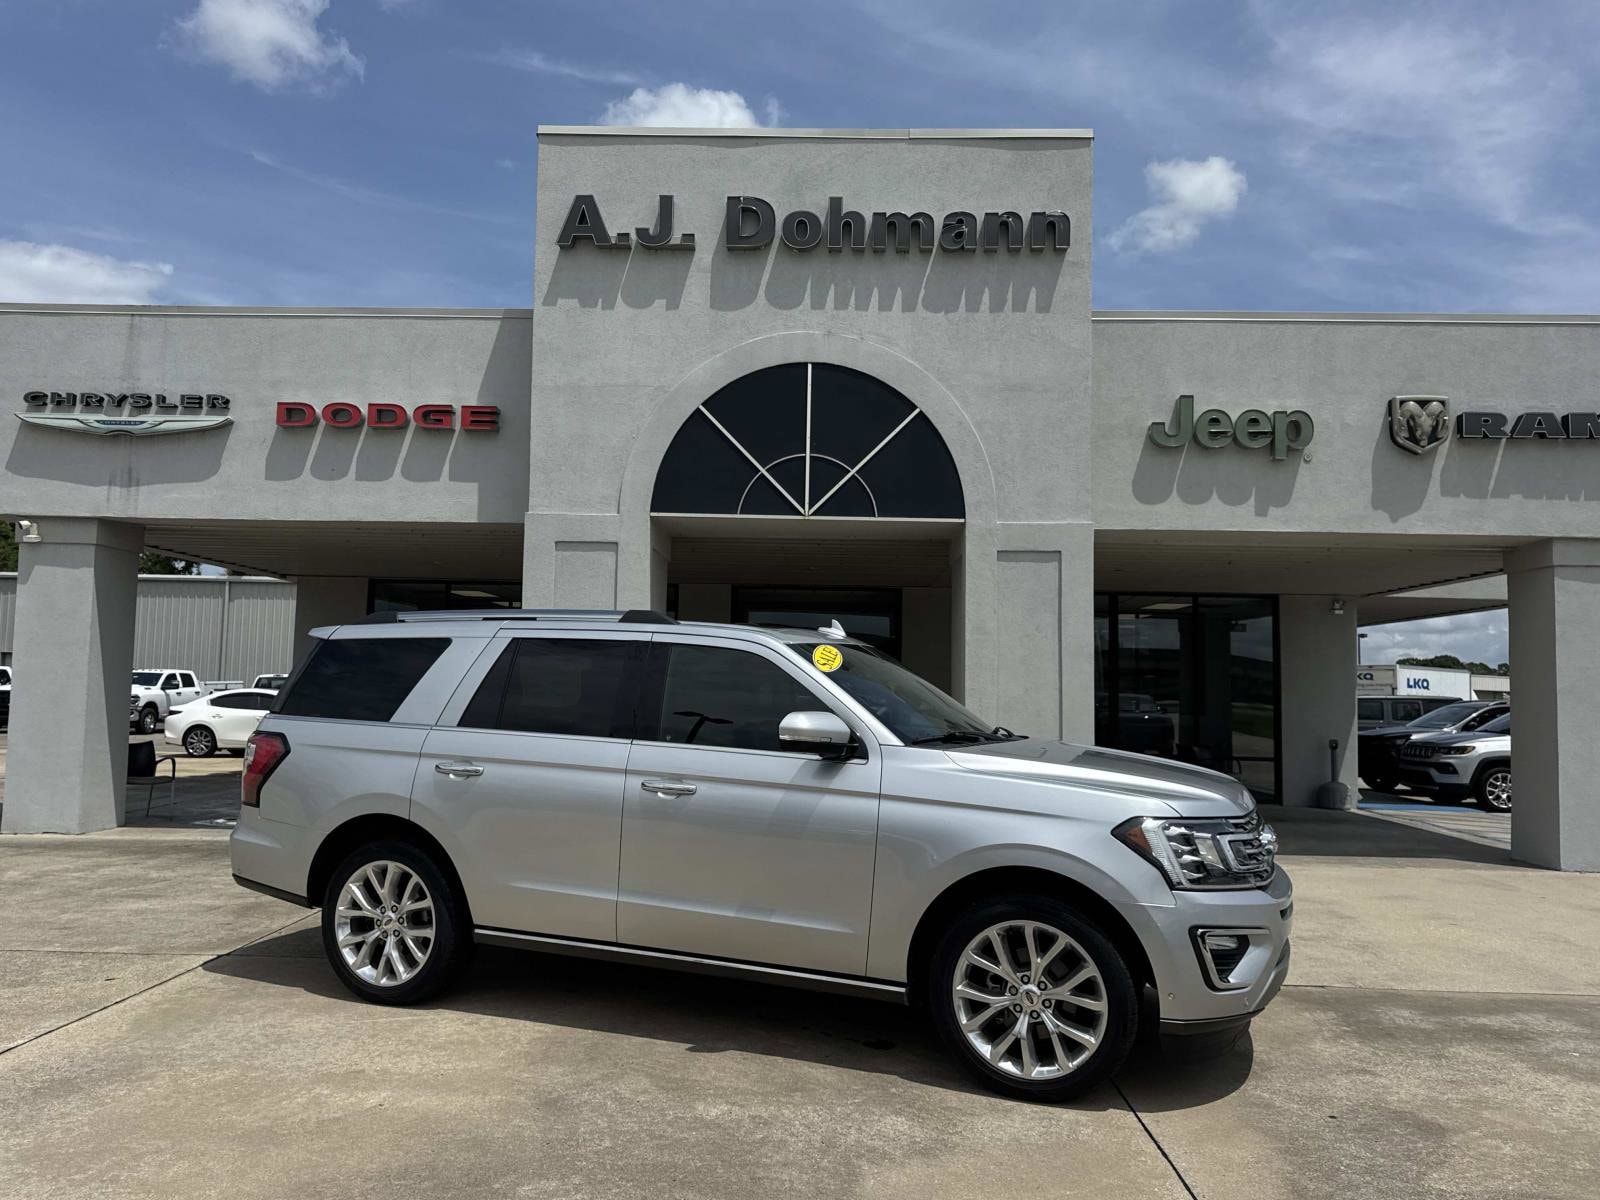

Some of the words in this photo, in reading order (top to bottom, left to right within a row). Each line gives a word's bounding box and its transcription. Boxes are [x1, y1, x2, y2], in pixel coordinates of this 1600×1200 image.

[555, 194, 695, 249] A.J.
[726, 195, 1071, 253] Dohmann
[23, 391, 230, 409] CHRYSLER
[275, 401, 500, 433] DODGE
[1148, 395, 1315, 460] Jeep
[1357, 672, 1374, 680] KQ
[1406, 677, 1430, 690] LKQ
